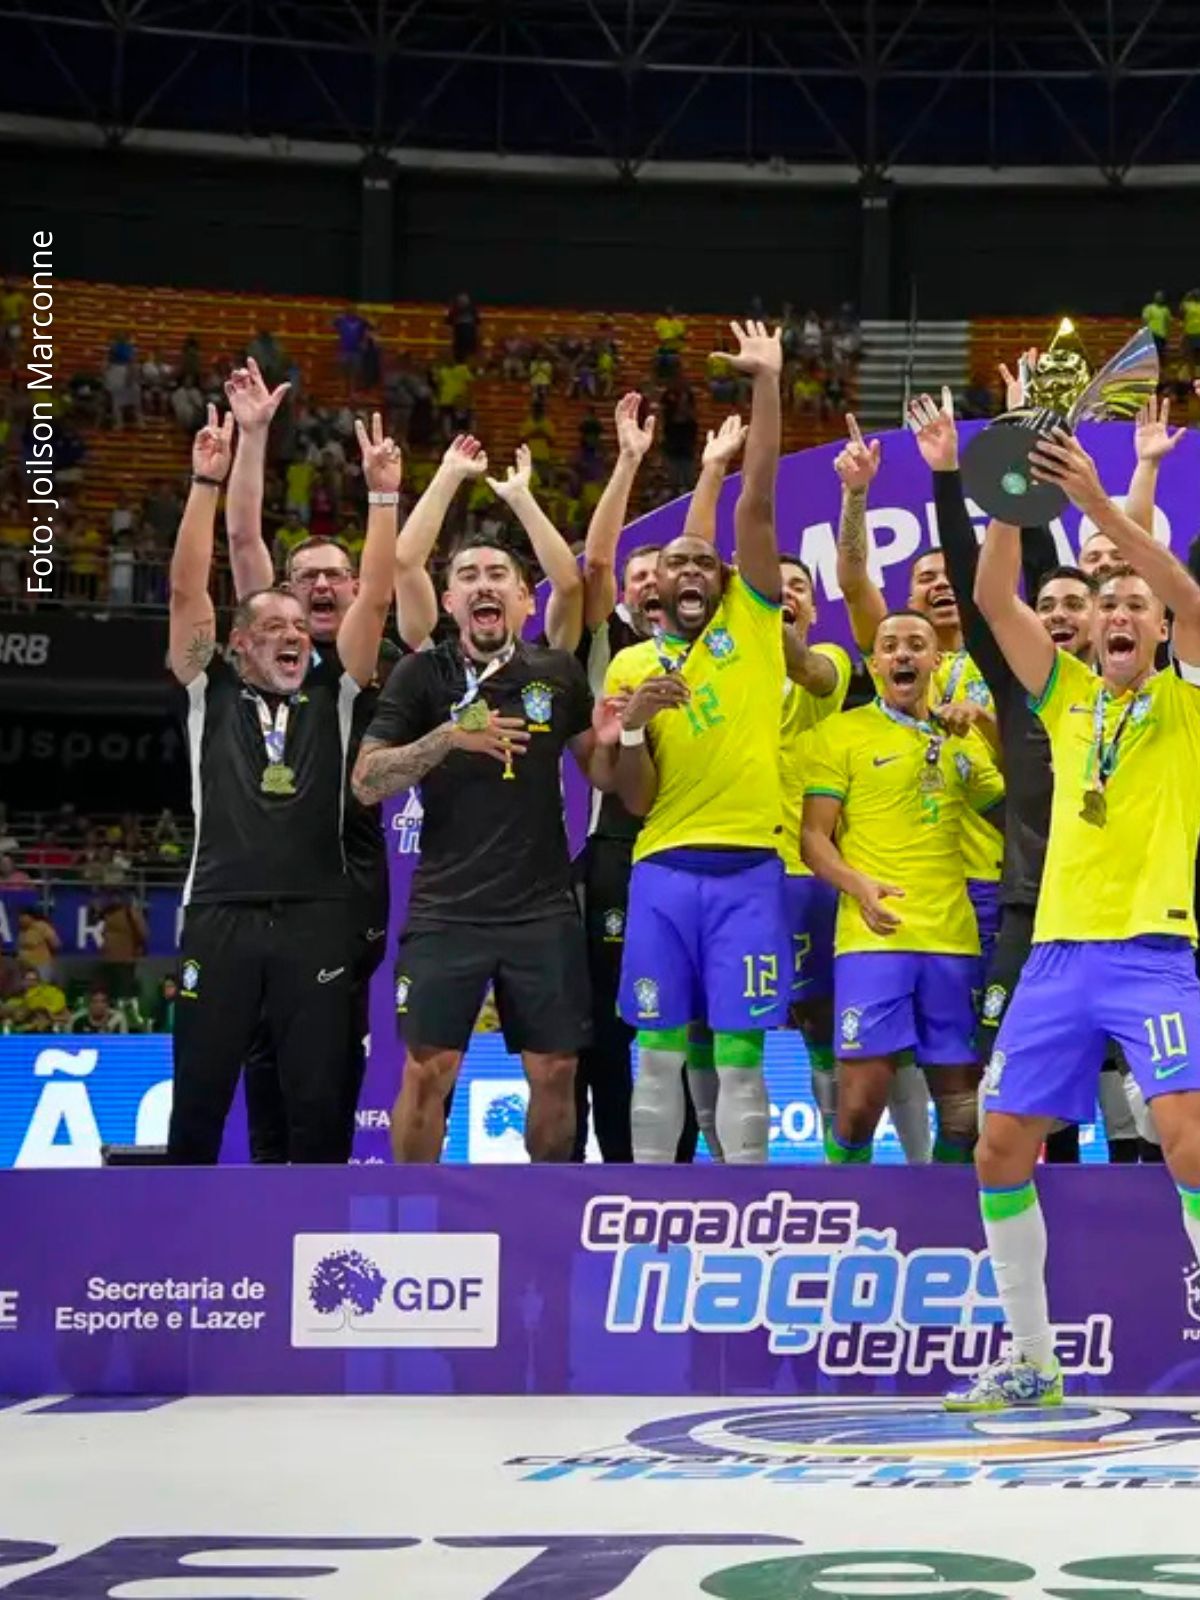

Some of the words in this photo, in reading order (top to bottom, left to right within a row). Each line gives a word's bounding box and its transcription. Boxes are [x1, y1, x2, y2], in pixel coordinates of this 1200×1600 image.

[0, 633, 50, 666] RB
[742, 954, 779, 998] 12
[1144, 1011, 1188, 1062] 10
[584, 1199, 734, 1253] Copa
[743, 1196, 855, 1247] das
[86, 1276, 224, 1301] Secretaria
[231, 1276, 266, 1301] de
[392, 1276, 484, 1312] GDF
[55, 1306, 159, 1335] Esporte
[166, 1312, 183, 1330] e
[190, 1306, 266, 1330] Lazer
[822, 1321, 898, 1370] de
[911, 1320, 1108, 1371] Futal
